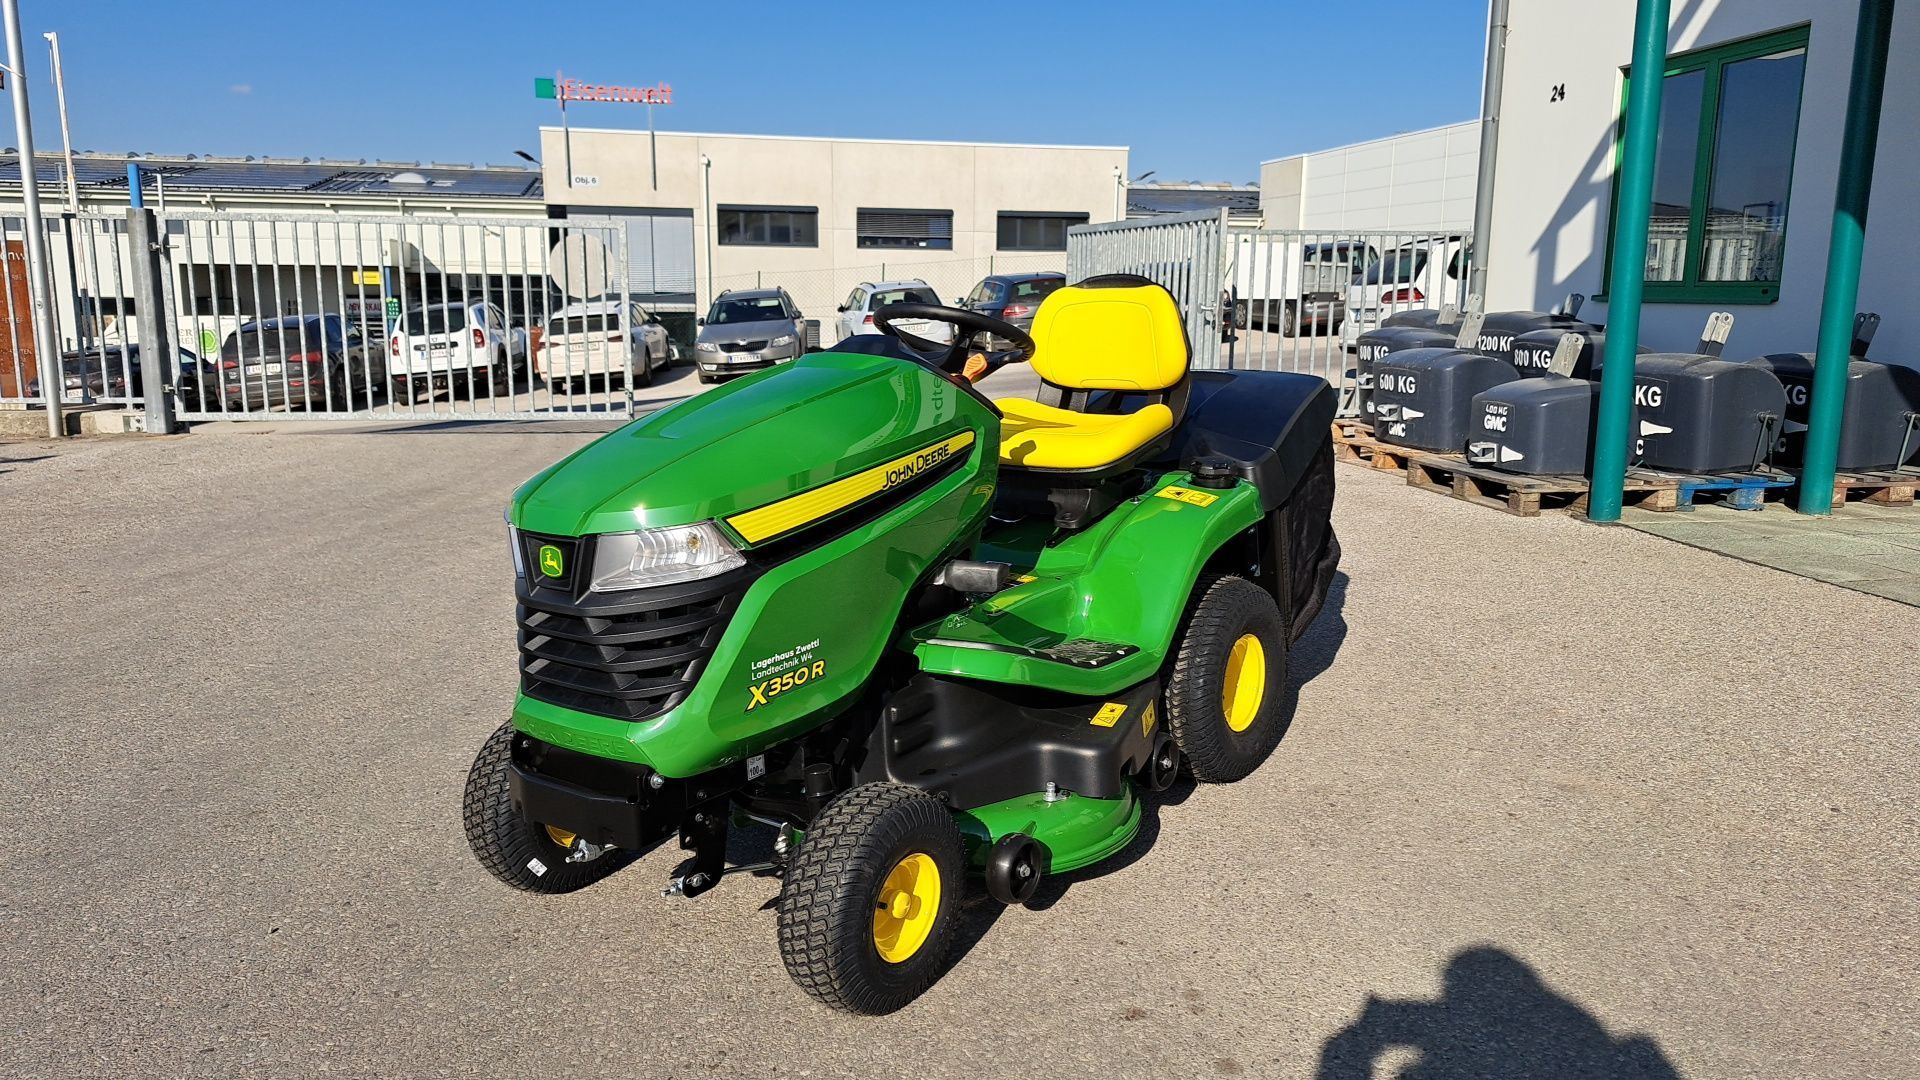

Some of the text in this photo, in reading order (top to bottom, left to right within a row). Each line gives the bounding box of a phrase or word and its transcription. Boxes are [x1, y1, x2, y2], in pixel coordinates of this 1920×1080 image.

[564, 78, 673, 105] Eisenwelt
[1550, 83, 1566, 103] 24
[575, 176, 590, 184] Obj.
[1478, 334, 1498, 352] 1200
[1514, 349, 1551, 369] 800 KG
[1379, 374, 1416, 394] 600 KG
[1635, 384, 1662, 407] KG
[1388, 422, 1406, 438] GMC
[1484, 414, 1507, 432] GMC
[882, 443, 951, 489] JOHN DEERE
[751, 639, 820, 670] Lagerhaus Zwettl
[751, 652, 813, 681] Landtechnik W4
